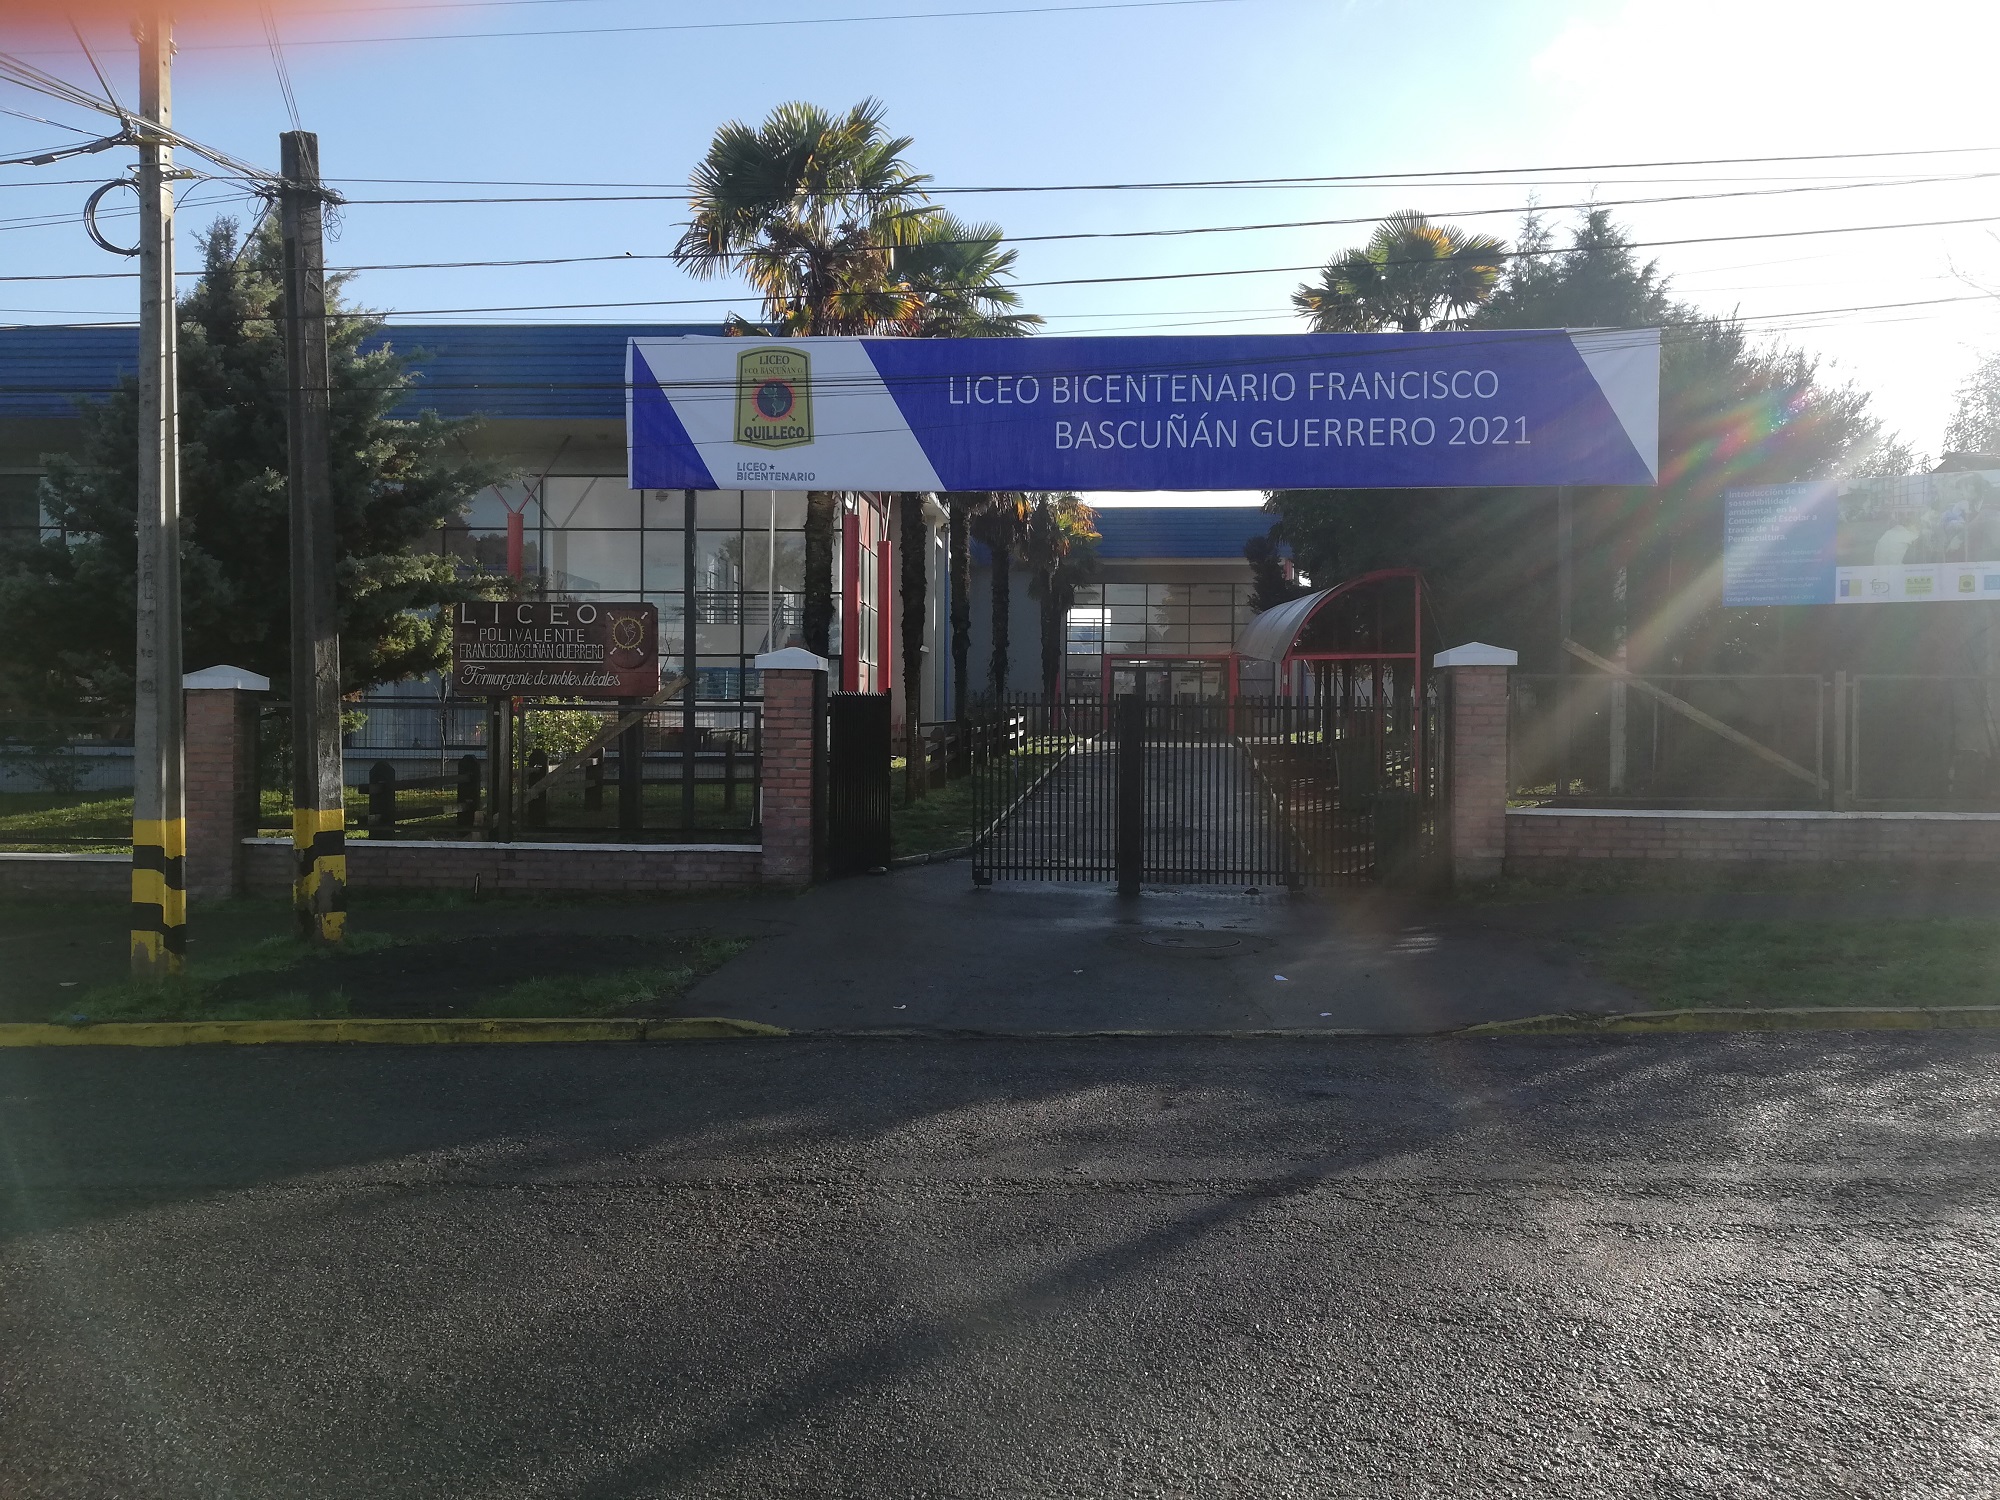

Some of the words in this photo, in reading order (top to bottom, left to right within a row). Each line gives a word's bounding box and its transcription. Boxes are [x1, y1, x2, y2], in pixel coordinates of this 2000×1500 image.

[760, 355, 790, 365] LICEO
[949, 375, 1040, 404] LICEO
[1053, 372, 1295, 403] BICENTENARIO
[1310, 369, 1499, 401] FRANCISCO
[744, 426, 805, 440] QUILLECO
[1055, 411, 1238, 450] BASCUÑÁN
[1250, 417, 1436, 449] GUERRERO
[1448, 416, 1531, 446] 2021
[737, 462, 767, 471] LICEO
[736, 472, 816, 481] BICENTENARIO
[1729, 488, 1783, 498] Introducción
[1785, 487, 1795, 495] de
[1798, 487, 1807, 495] la
[1729, 497, 1789, 507] sostenibilidad
[1728, 506, 1772, 516] ambiental
[1728, 515, 1776, 525] Comunidad
[1779, 513, 1810, 523] Escolar
[1728, 525, 1754, 534] través
[1757, 524, 1767, 532] de
[461, 602, 597, 625] LICEO
[480, 627, 585, 643] POLIVALENTE
[460, 643, 509, 659] FRANCISCO
[509, 642, 554, 660] BASCUÑAN
[555, 643, 604, 660] GUERRERO
[461, 664, 507, 686] Formar
[502, 673, 534, 691] gente
[534, 669, 548, 686] de
[549, 669, 581, 686] nobles
[582, 670, 621, 687] ideales
